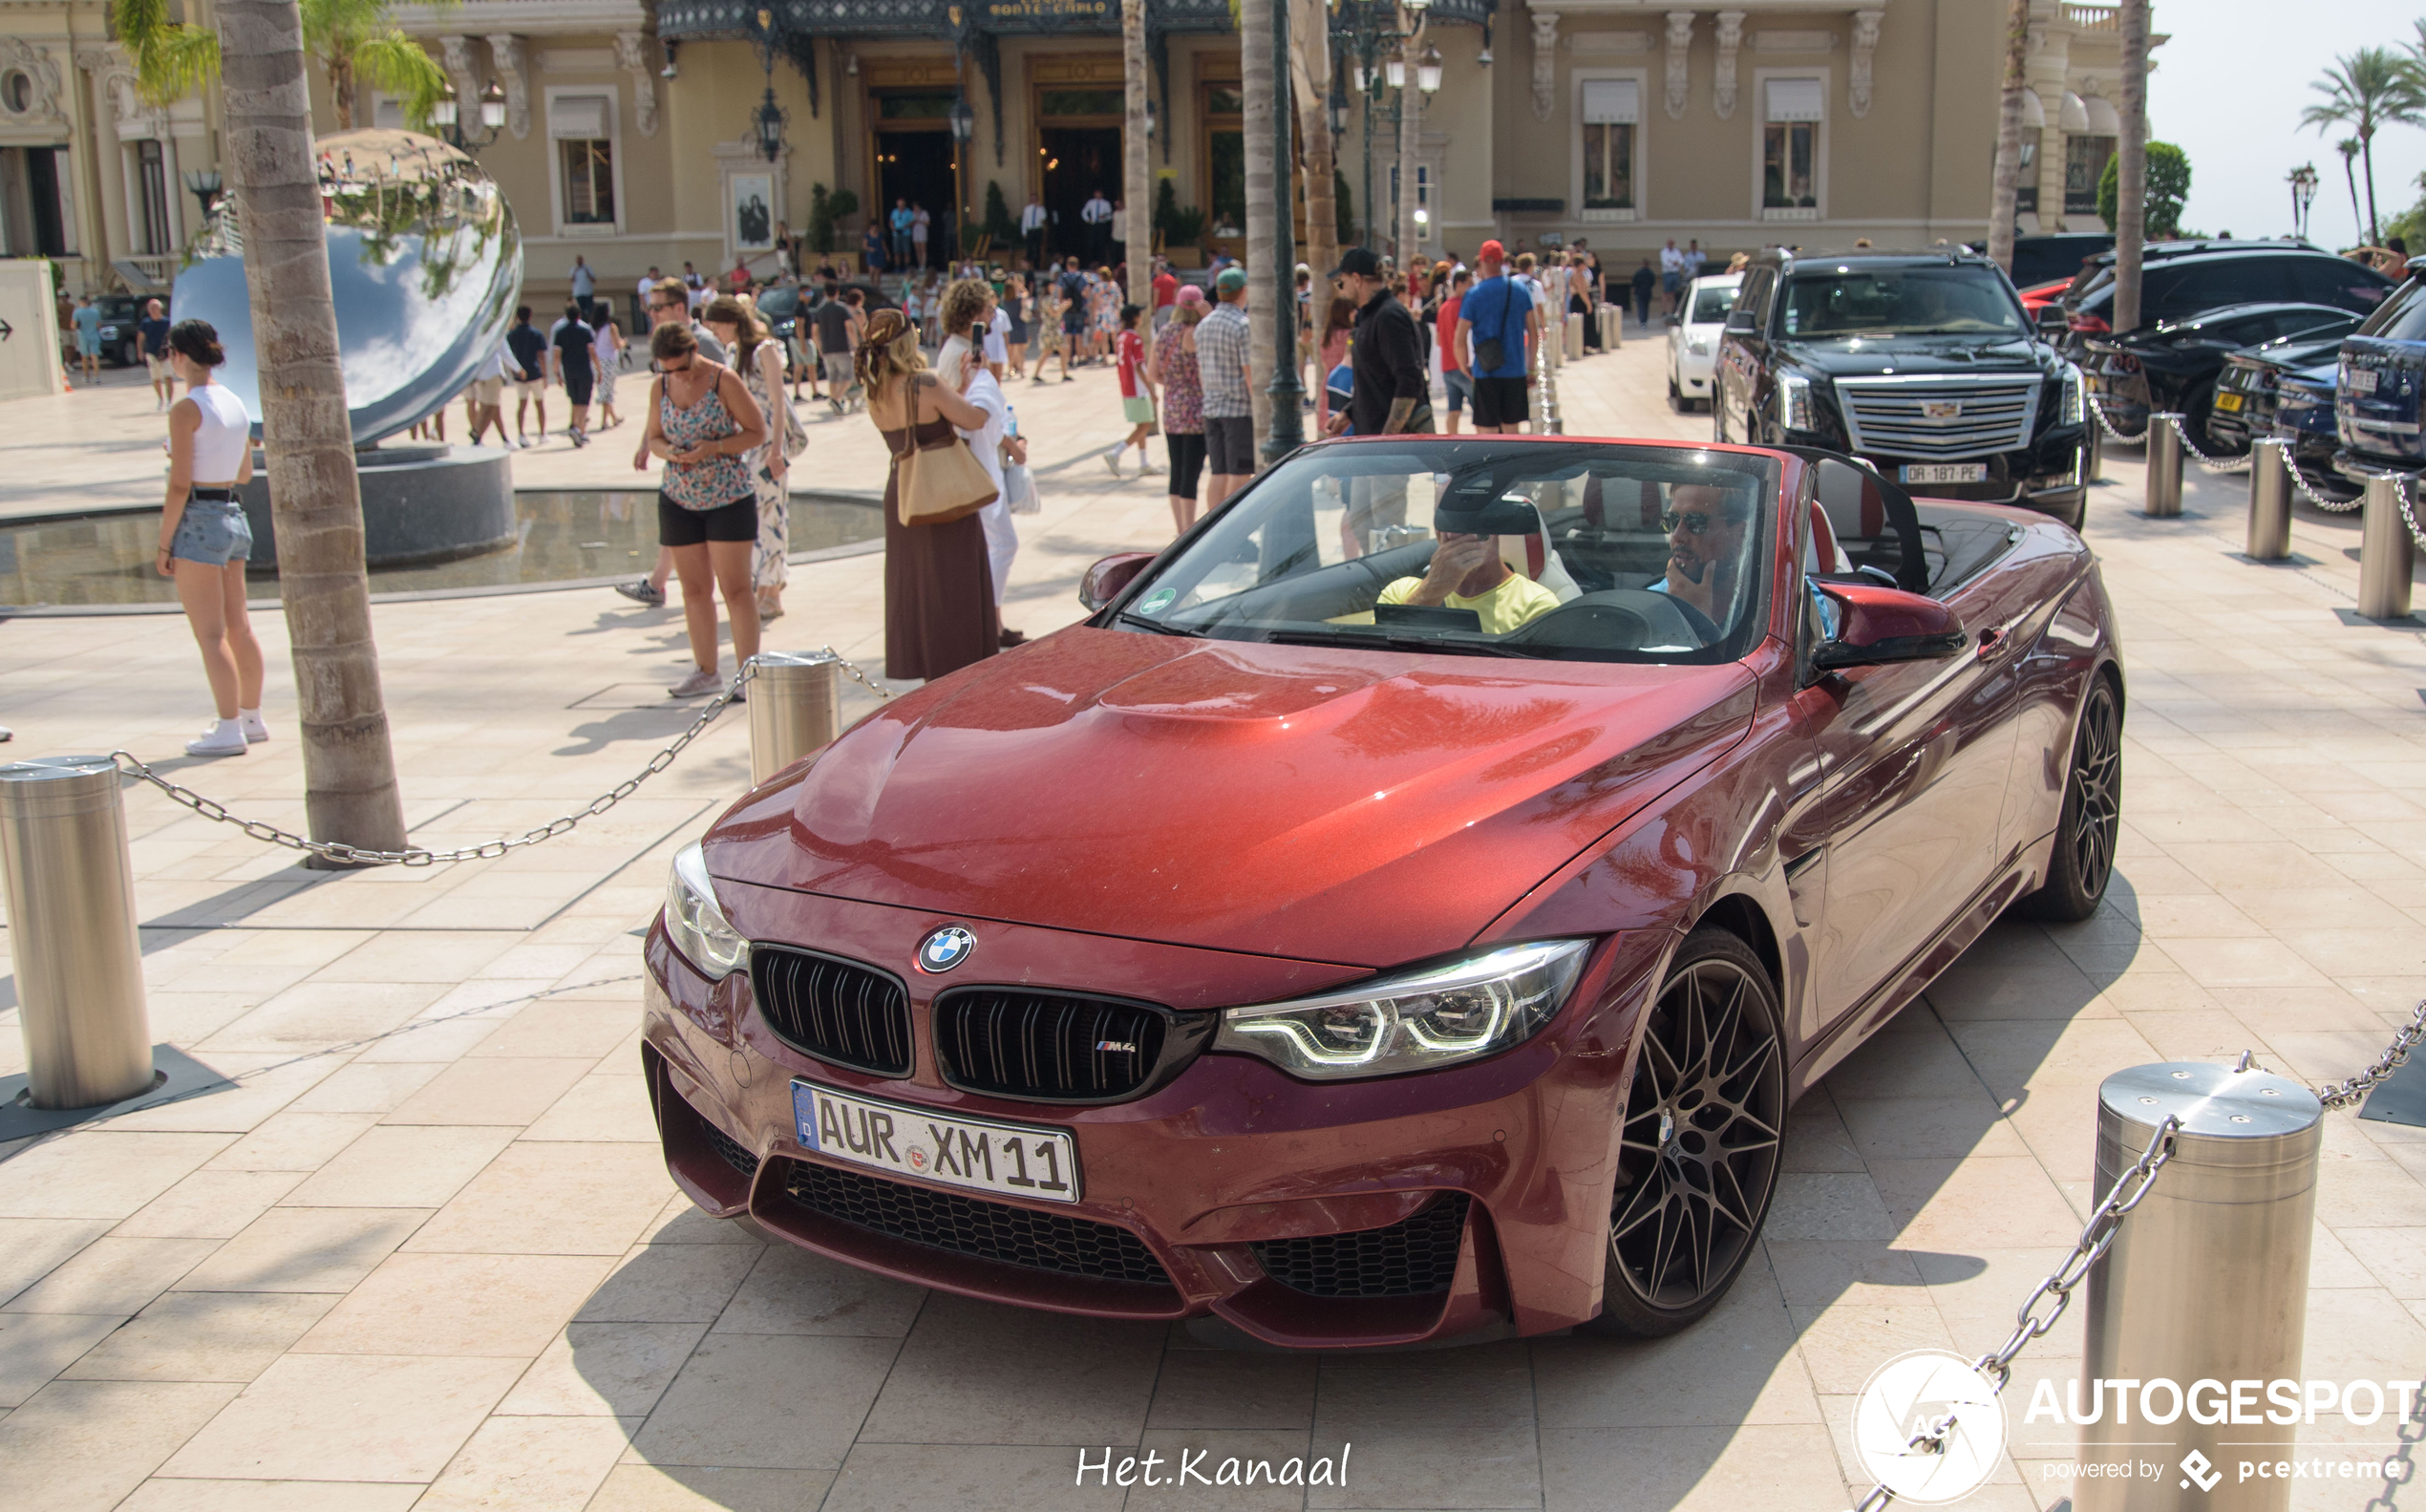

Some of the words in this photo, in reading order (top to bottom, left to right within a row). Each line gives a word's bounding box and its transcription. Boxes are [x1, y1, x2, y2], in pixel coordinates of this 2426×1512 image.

[934, 928, 970, 945] BMW
[1108, 1041, 1136, 1053] M4
[820, 1098, 900, 1163] AUR
